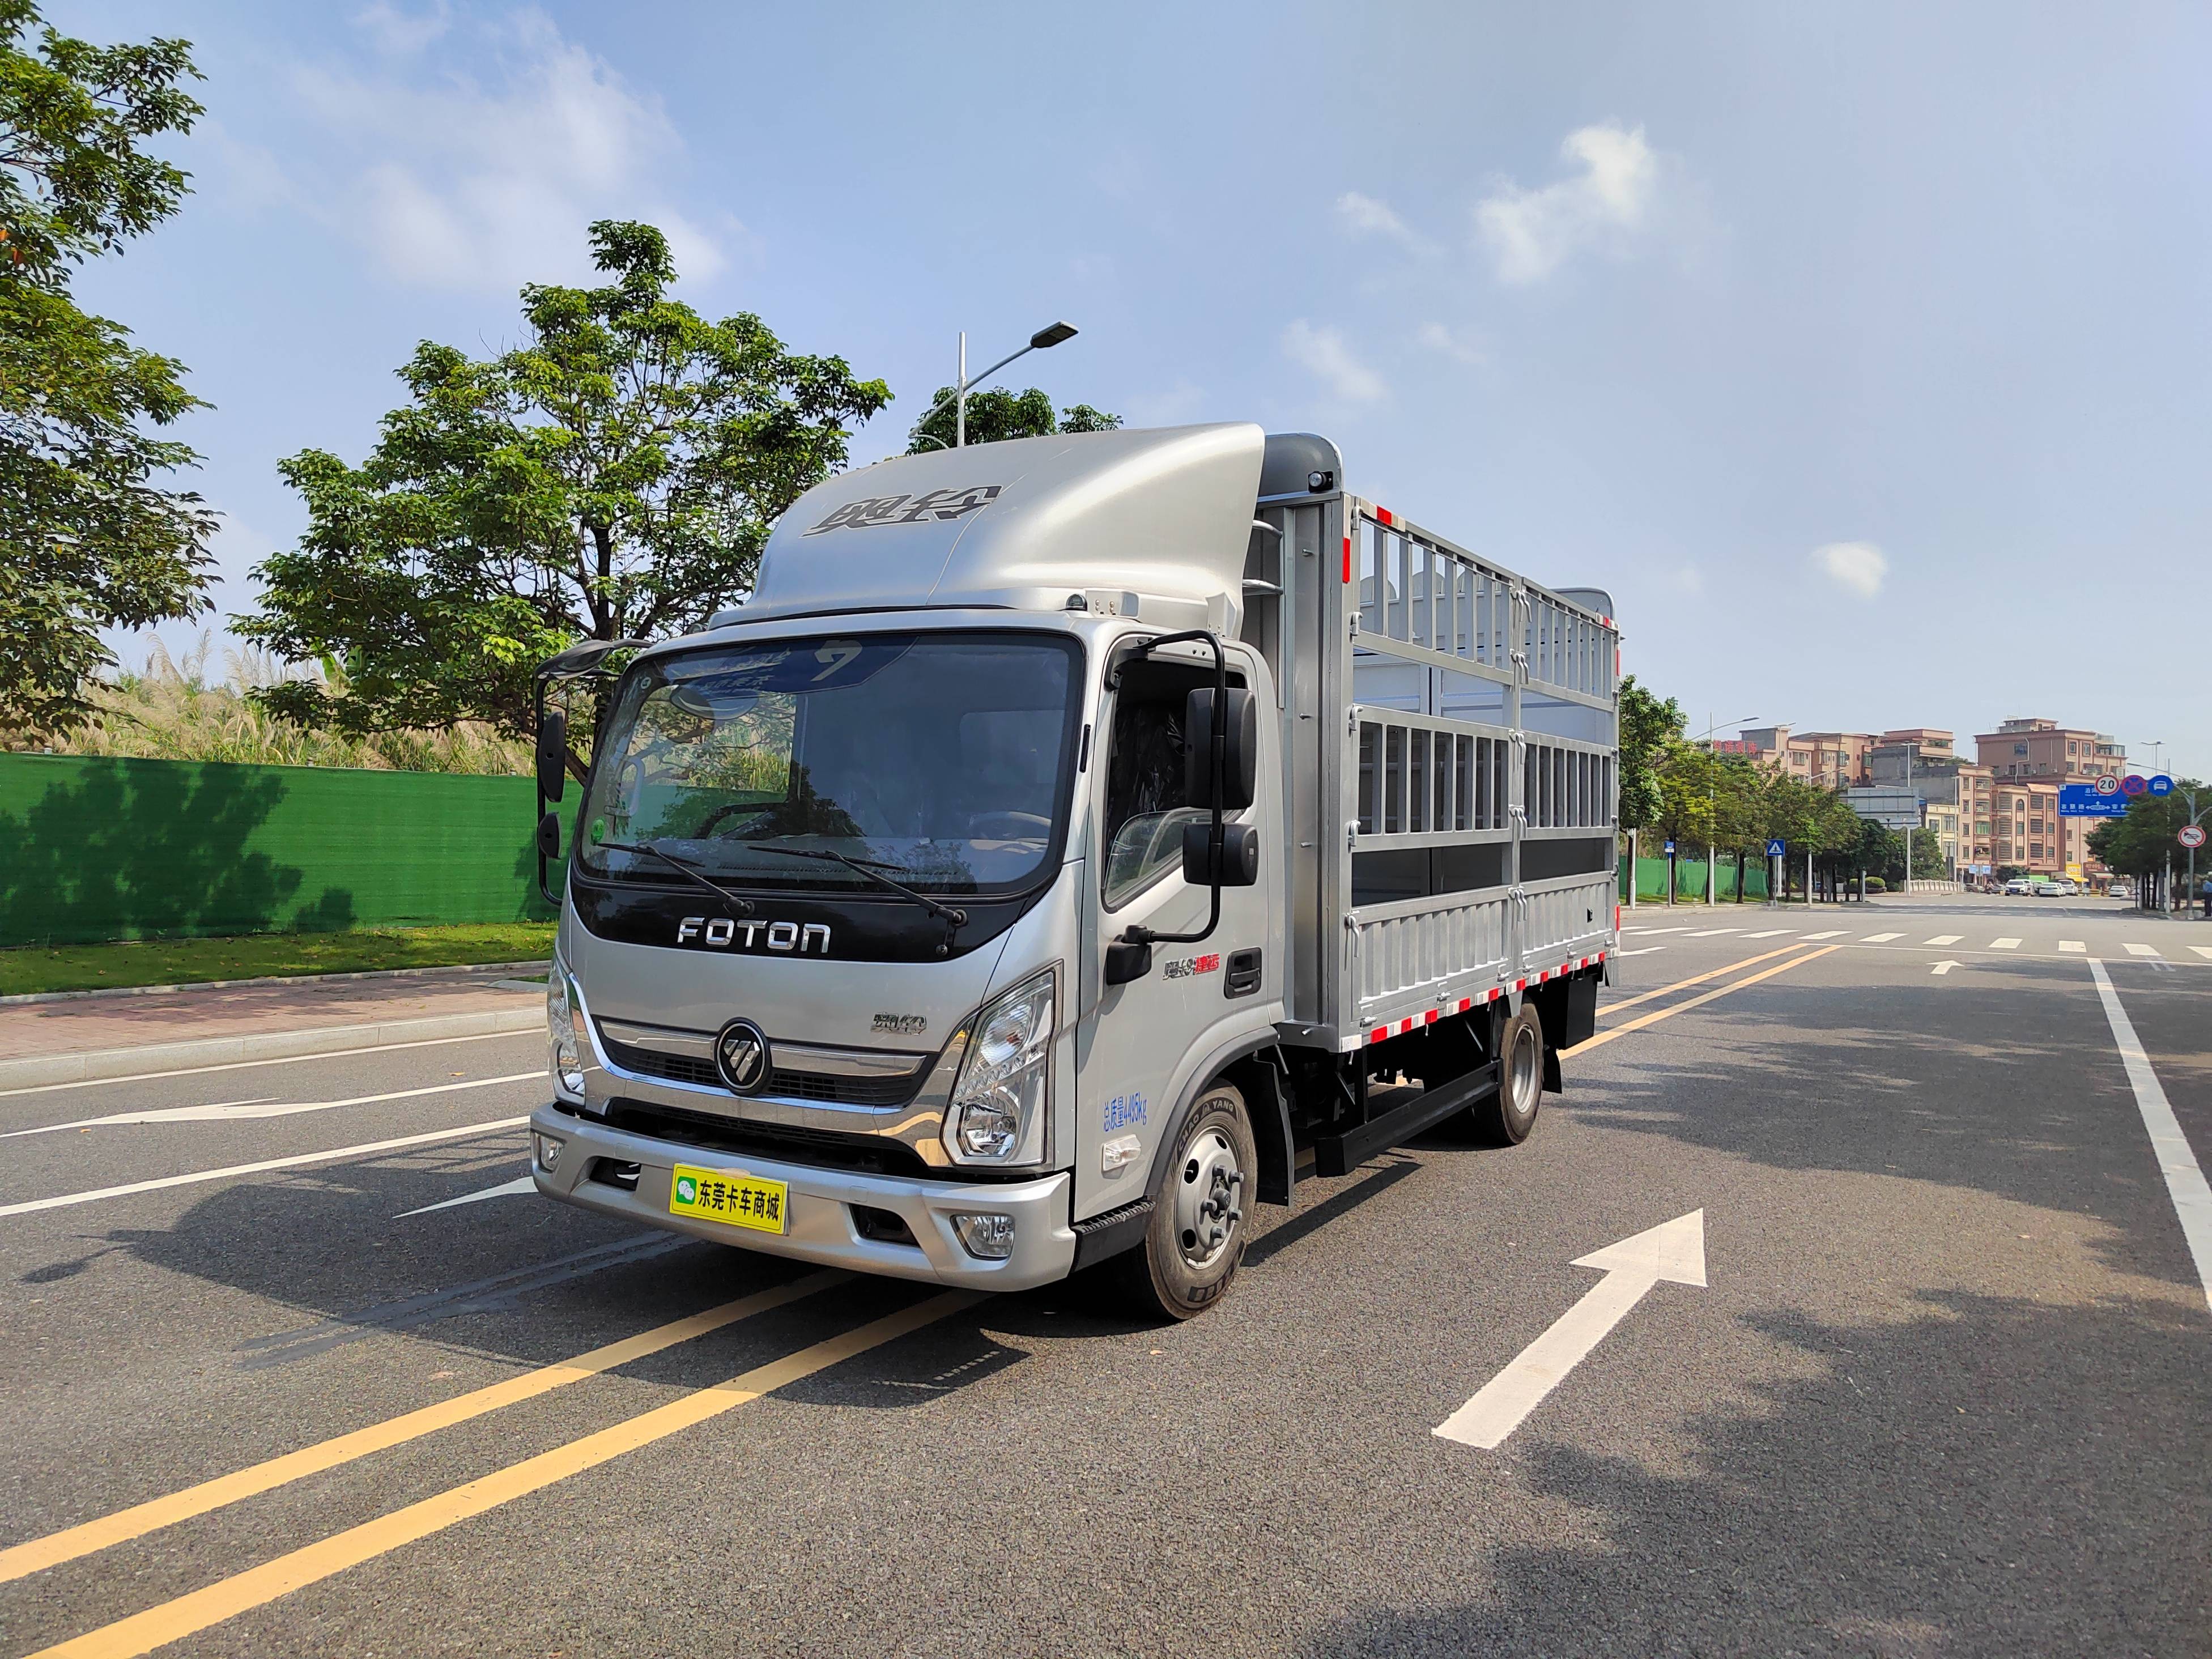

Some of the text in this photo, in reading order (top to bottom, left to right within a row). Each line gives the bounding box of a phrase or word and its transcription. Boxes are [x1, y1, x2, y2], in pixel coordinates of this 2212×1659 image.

[2100, 780, 2115, 789] 20
[677, 917, 831, 953] FOTON
[1103, 1091, 1147, 1132] 总质量4495kg
[1179, 1100, 1234, 1151] CHAO YANG
[699, 1180, 780, 1222] 东莞卡车商城
